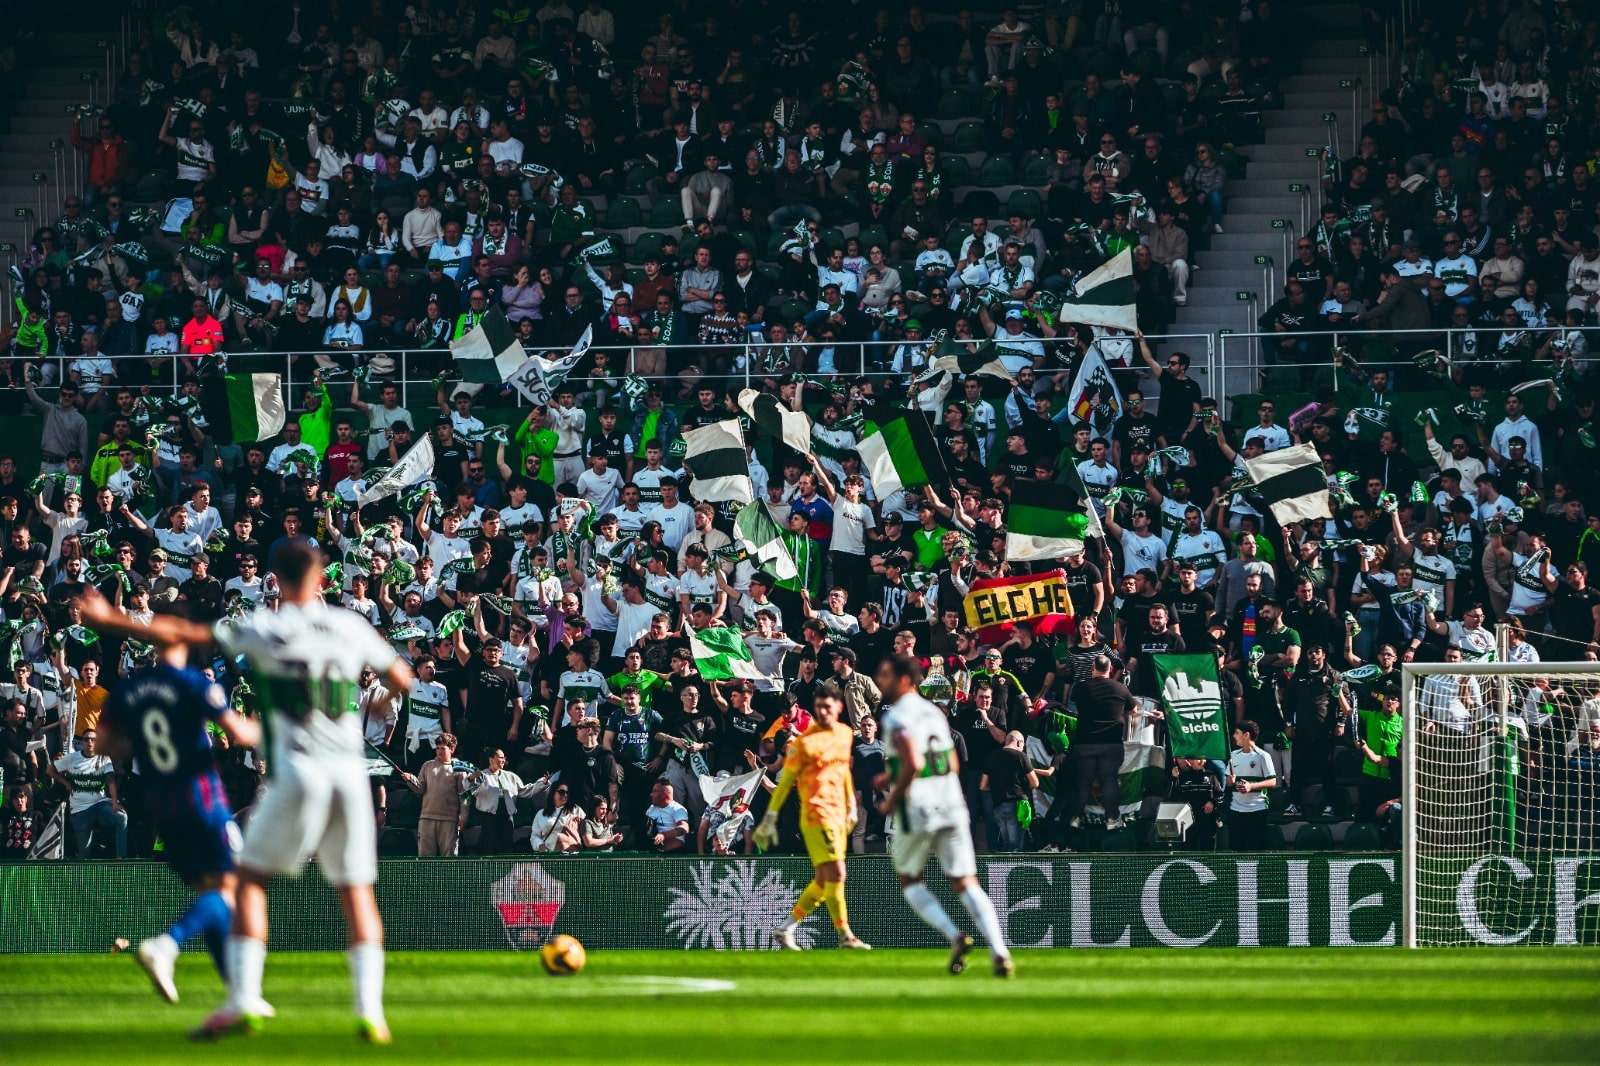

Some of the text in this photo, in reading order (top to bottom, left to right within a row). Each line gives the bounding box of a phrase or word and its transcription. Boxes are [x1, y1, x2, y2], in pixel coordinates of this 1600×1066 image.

[974, 584, 1066, 625] ELCHE
[142, 707, 180, 773] 8
[1181, 721, 1220, 734] elche
[988, 859, 1395, 948] ELCHE
